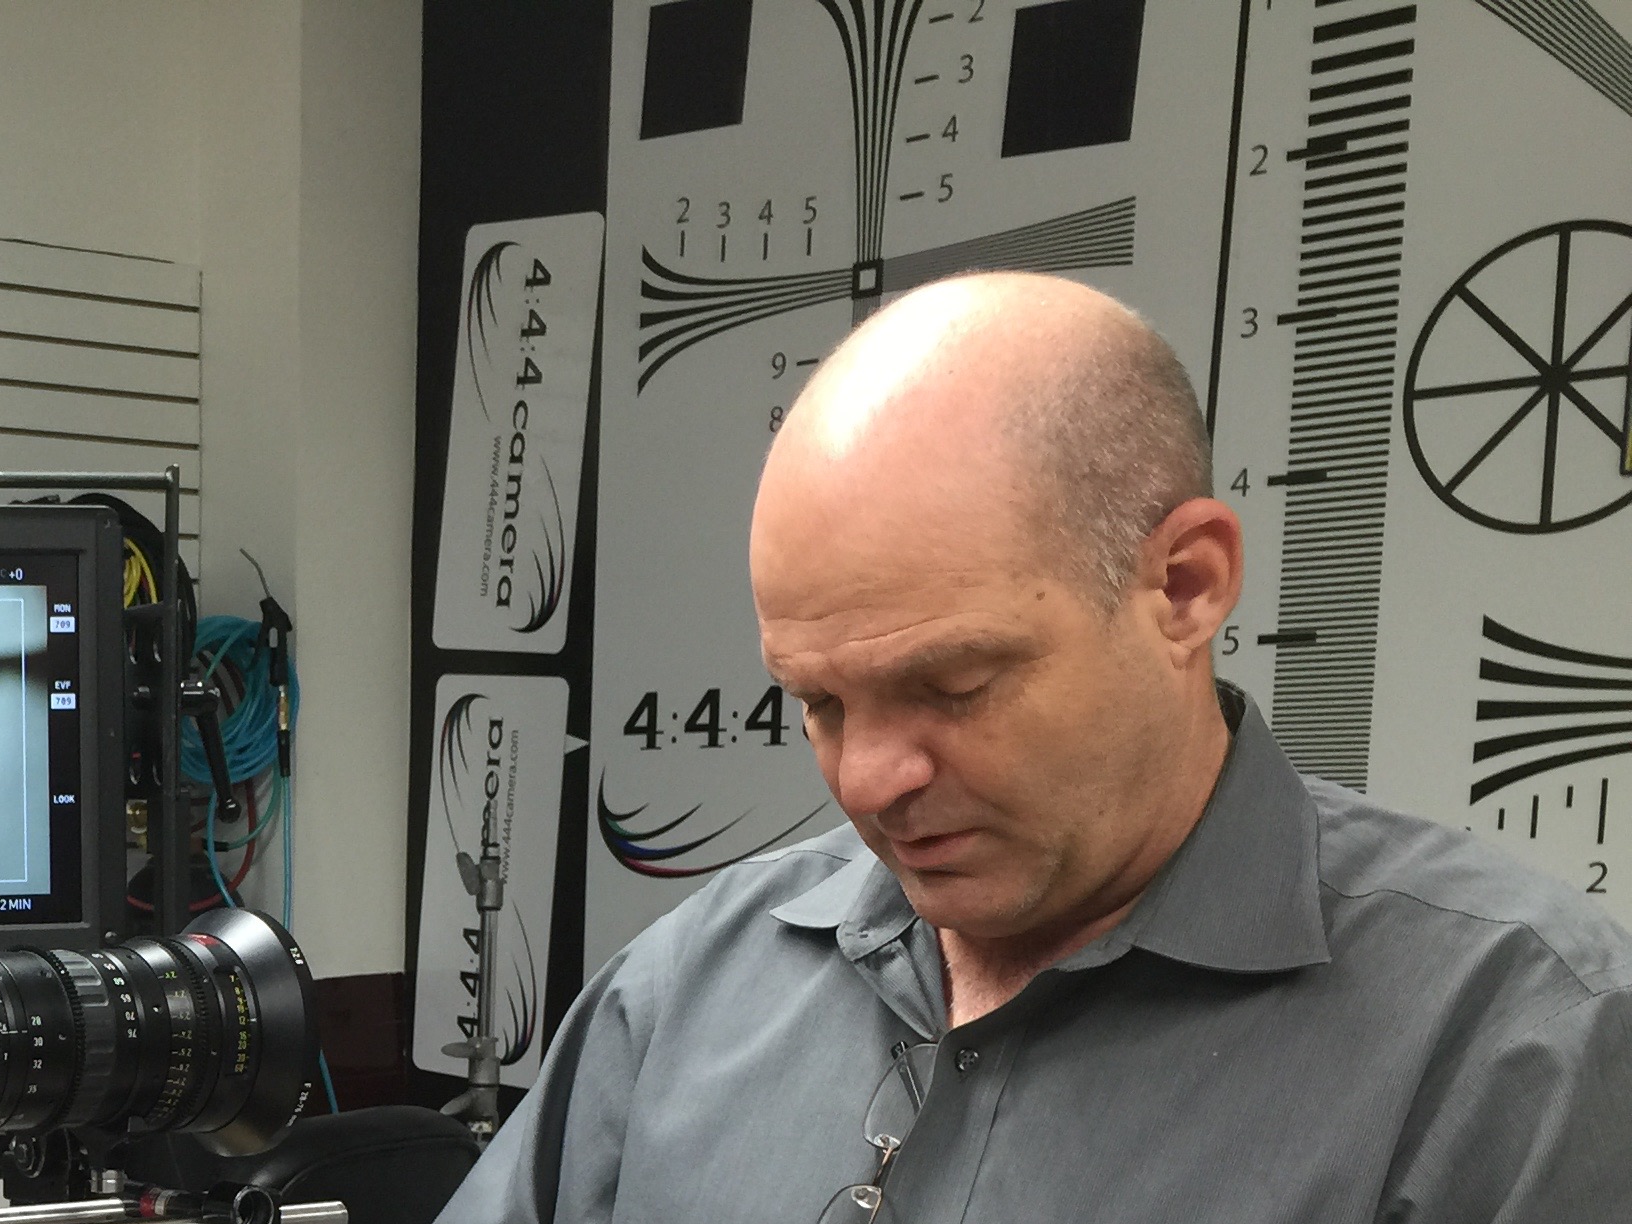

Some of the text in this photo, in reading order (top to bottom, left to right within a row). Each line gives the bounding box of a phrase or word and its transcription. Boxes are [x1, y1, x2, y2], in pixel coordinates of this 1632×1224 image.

[958, 53, 974, 83] 3
[941, 114, 959, 142] 4
[1250, 145, 1268, 176] 2
[938, 173, 953, 203] 5
[676, 195, 817, 229] 2 3 4 5
[1240, 308, 1259, 338] 3
[771, 351, 787, 380] 9
[1230, 467, 1251, 497] 4
[480, 435, 502, 597] www.444camera.com
[496, 400, 529, 609] camera
[8, 568, 23, 581] +0
[55, 619, 71, 629] 709
[1221, 625, 1240, 655] 5
[54, 680, 71, 690] EVF
[55, 696, 72, 706] 709
[623, 684, 791, 751] 4:4:4
[53, 795, 76, 804] LOOK
[1586, 862, 1608, 894] 2
[33, 1037, 44, 1047] 30
[32, 1059, 43, 1069] 32
